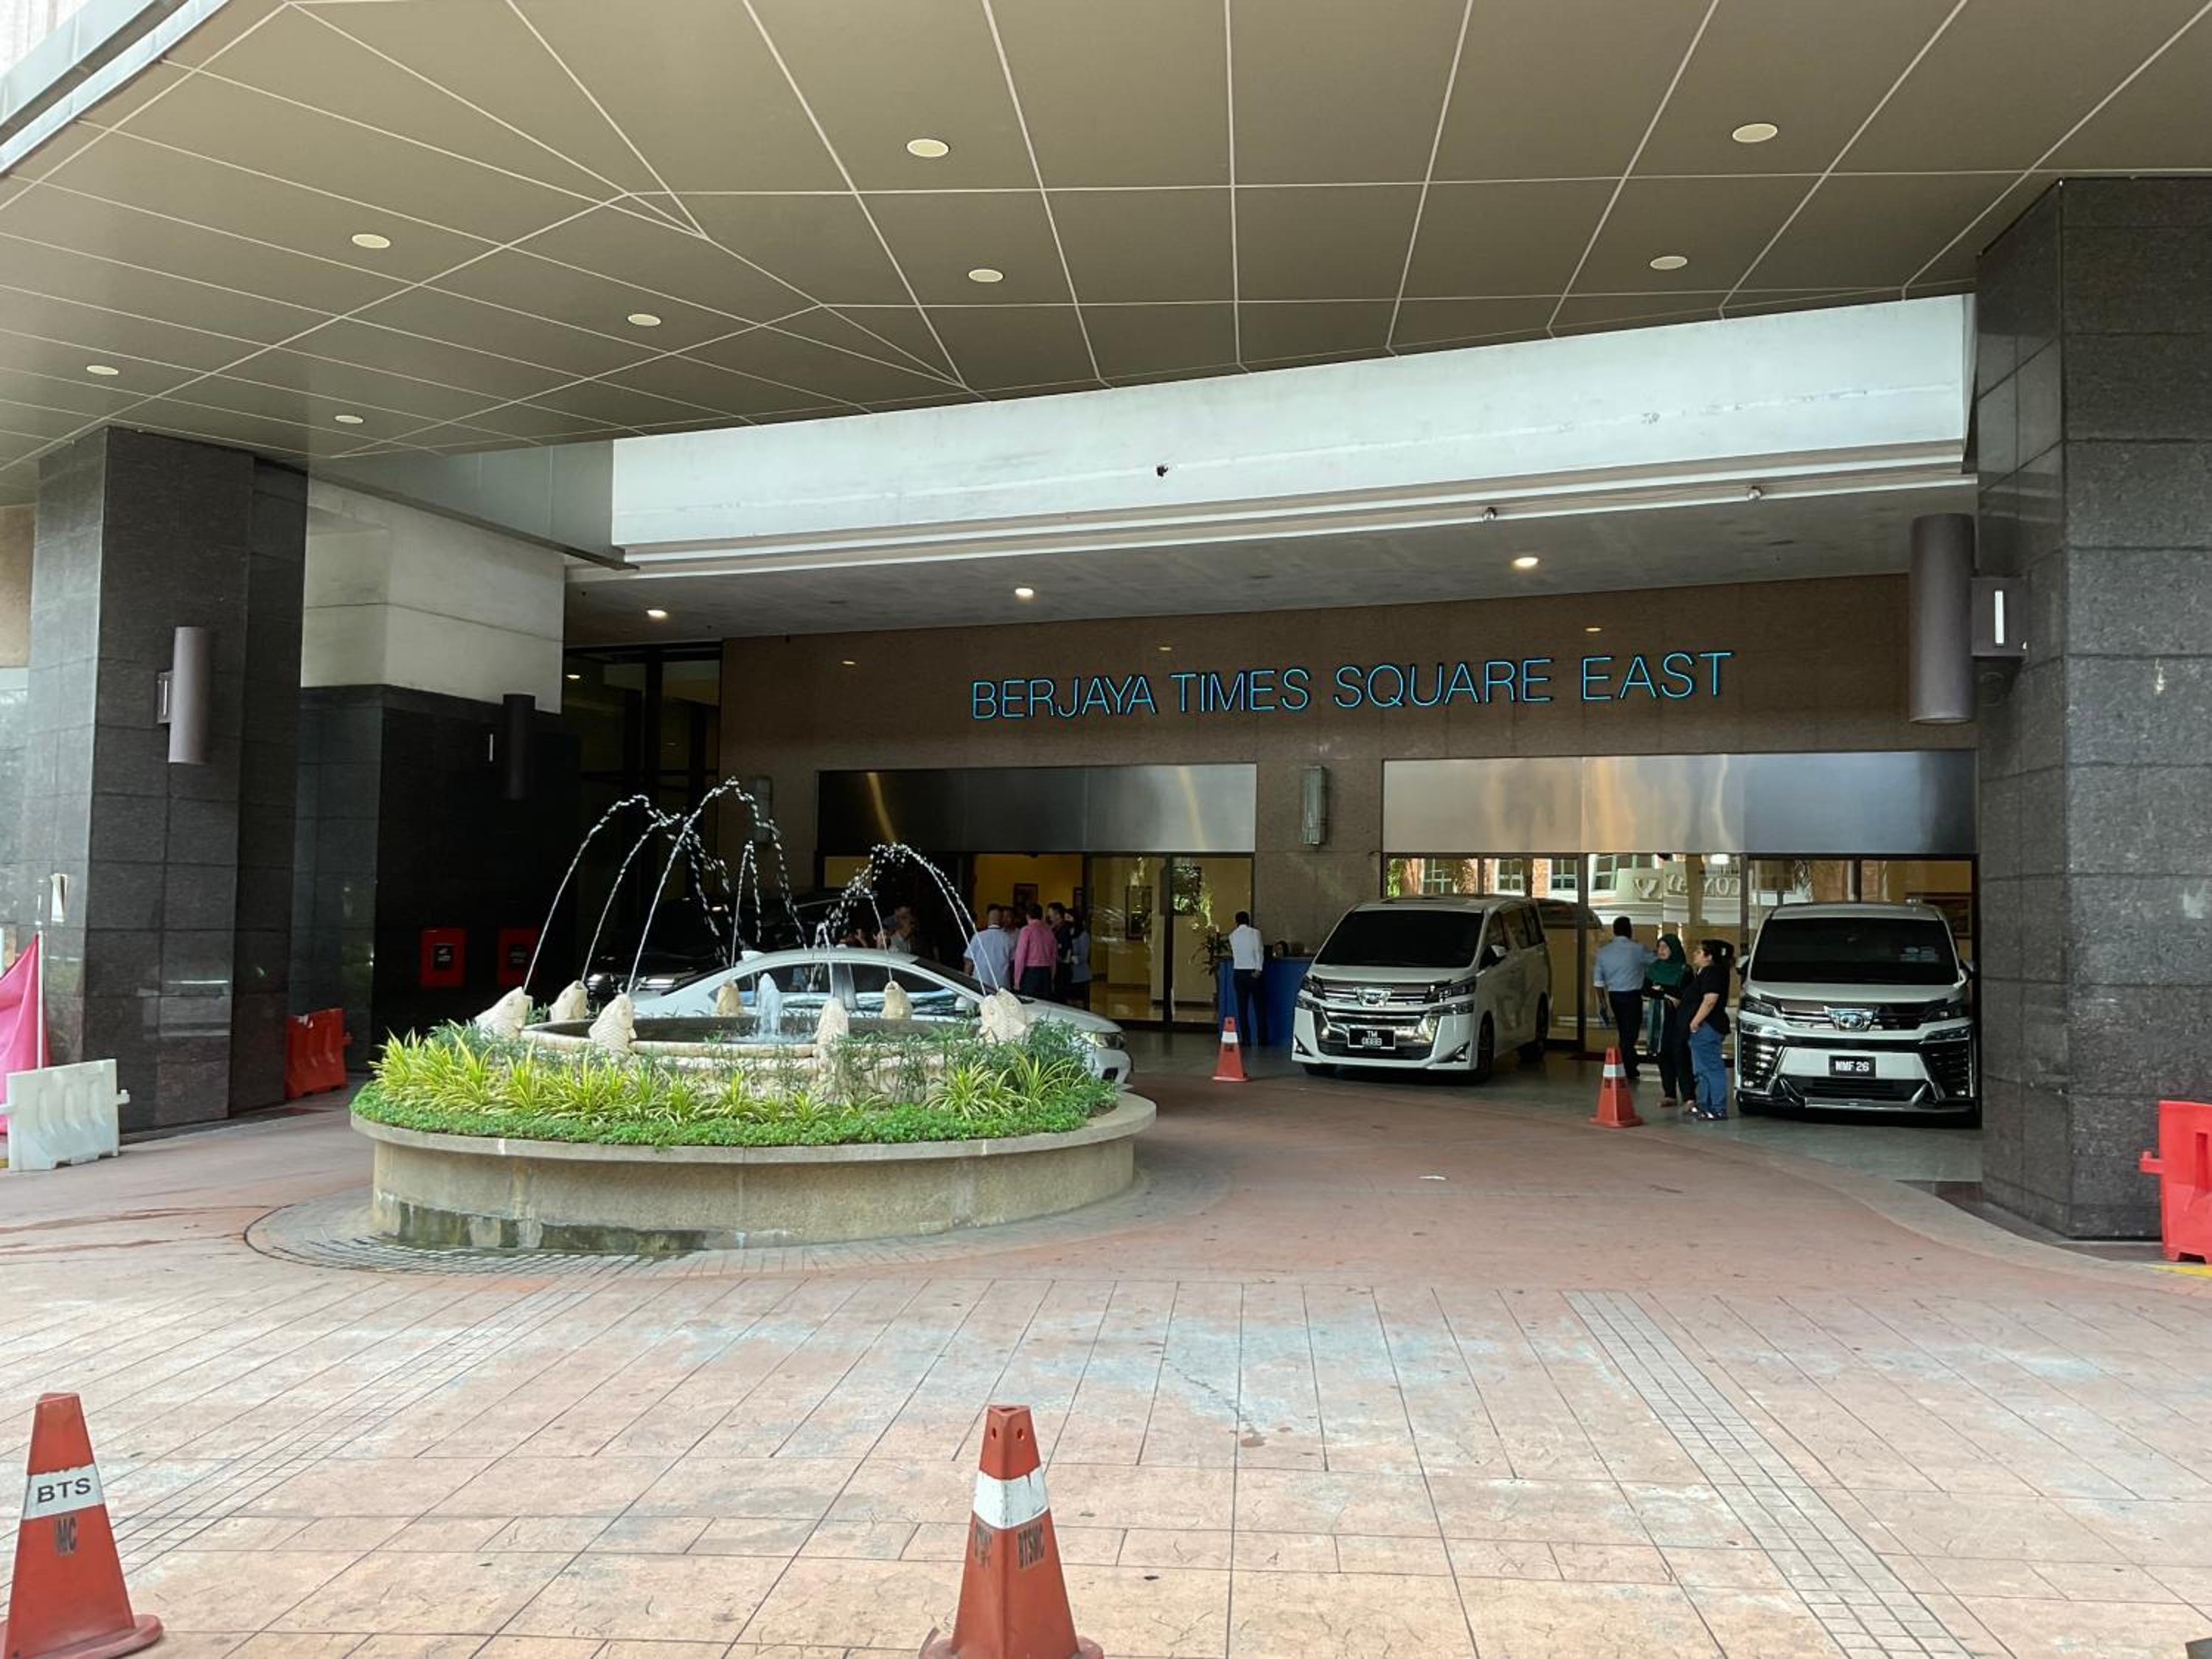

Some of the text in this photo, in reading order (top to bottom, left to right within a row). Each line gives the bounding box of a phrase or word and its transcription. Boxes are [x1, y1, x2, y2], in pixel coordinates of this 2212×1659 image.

[972, 653, 1732, 720] BERJAYA TIMES SQUARE EAST
[38, 1478, 91, 1503] BTS
